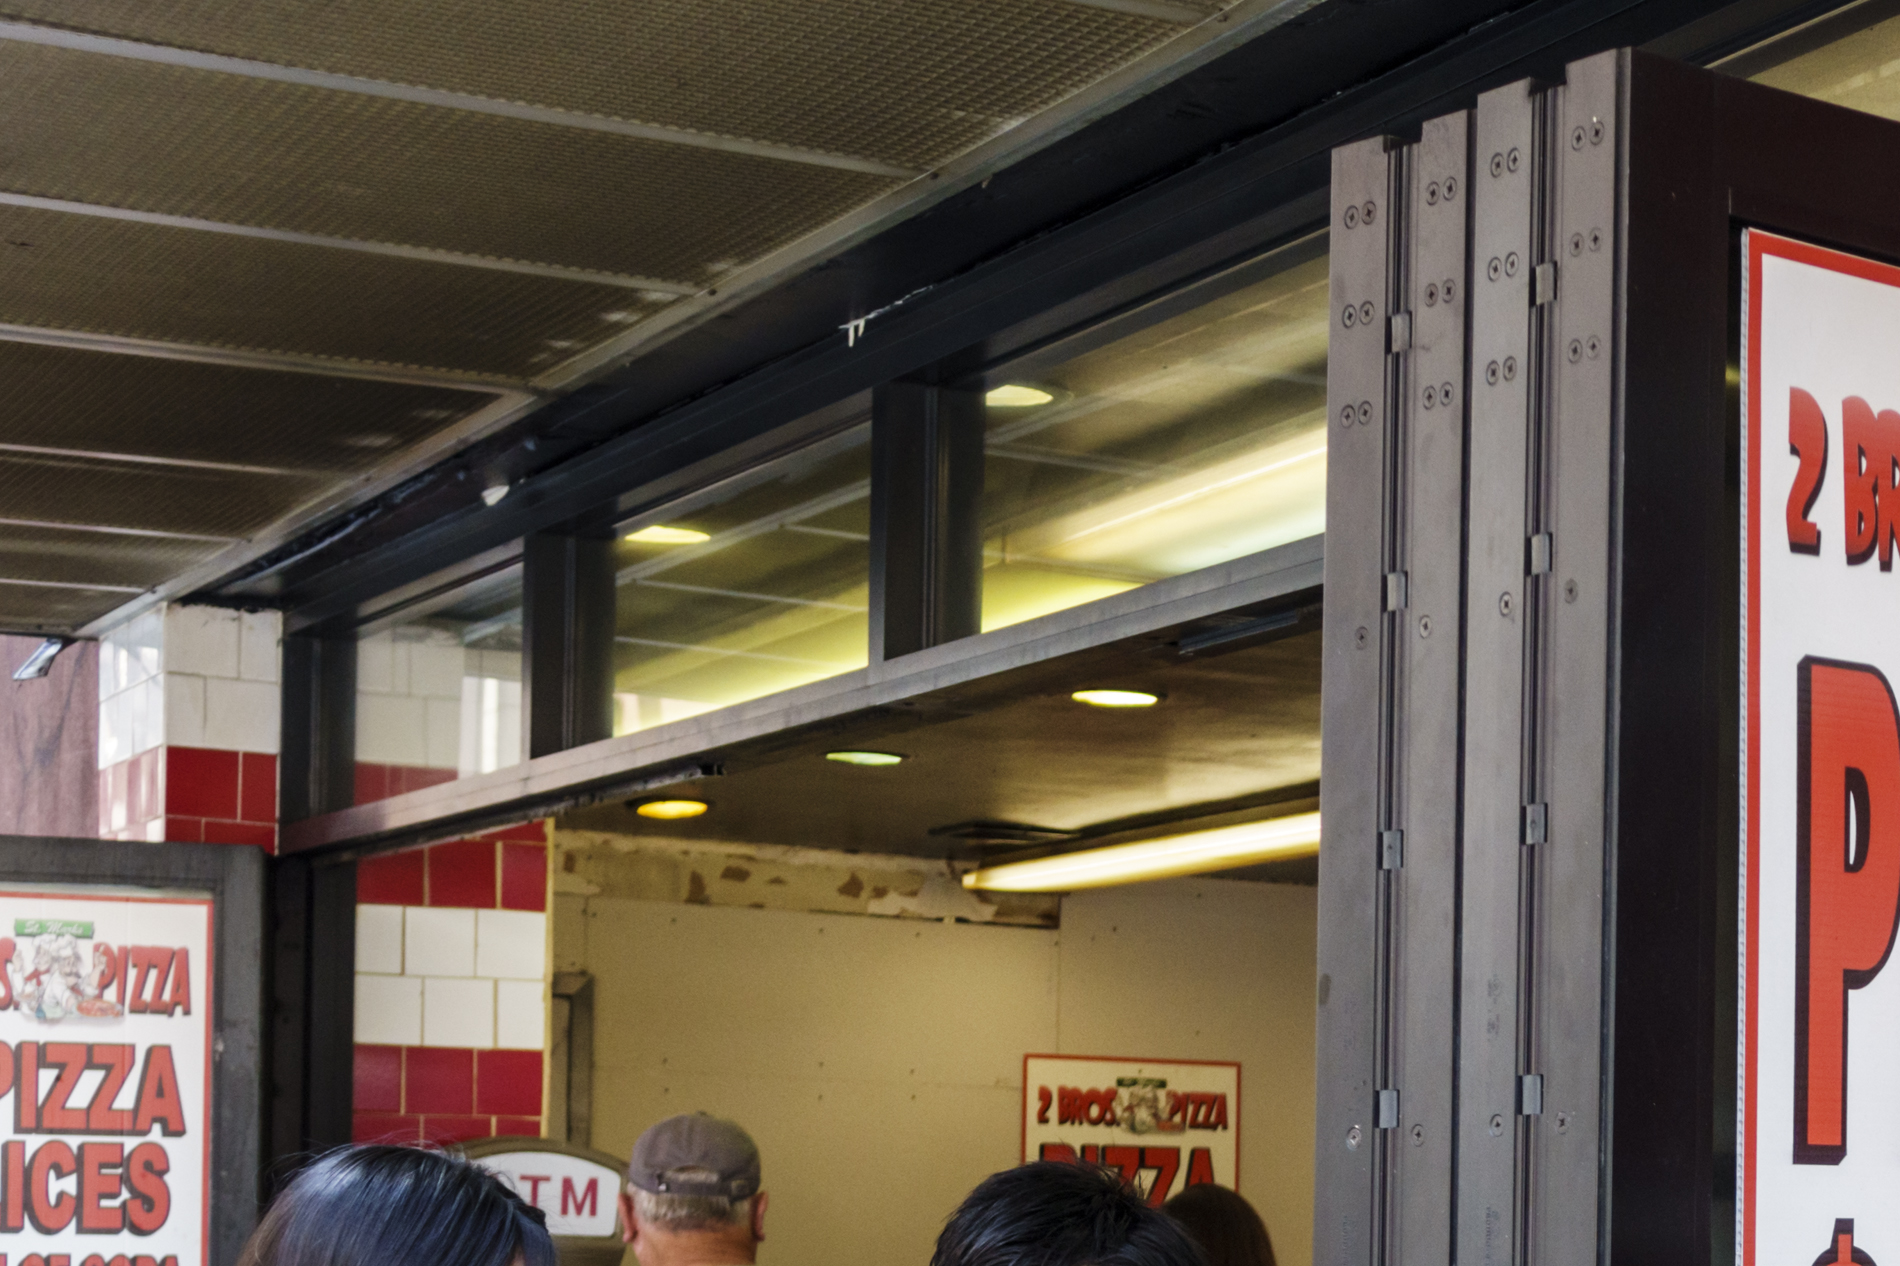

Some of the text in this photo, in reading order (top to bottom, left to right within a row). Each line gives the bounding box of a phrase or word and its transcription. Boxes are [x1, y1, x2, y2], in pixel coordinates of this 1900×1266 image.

[1786, 386, 1828, 556] 2
[93, 941, 191, 1018] PIZZA
[1037, 1085, 1052, 1125] 2
